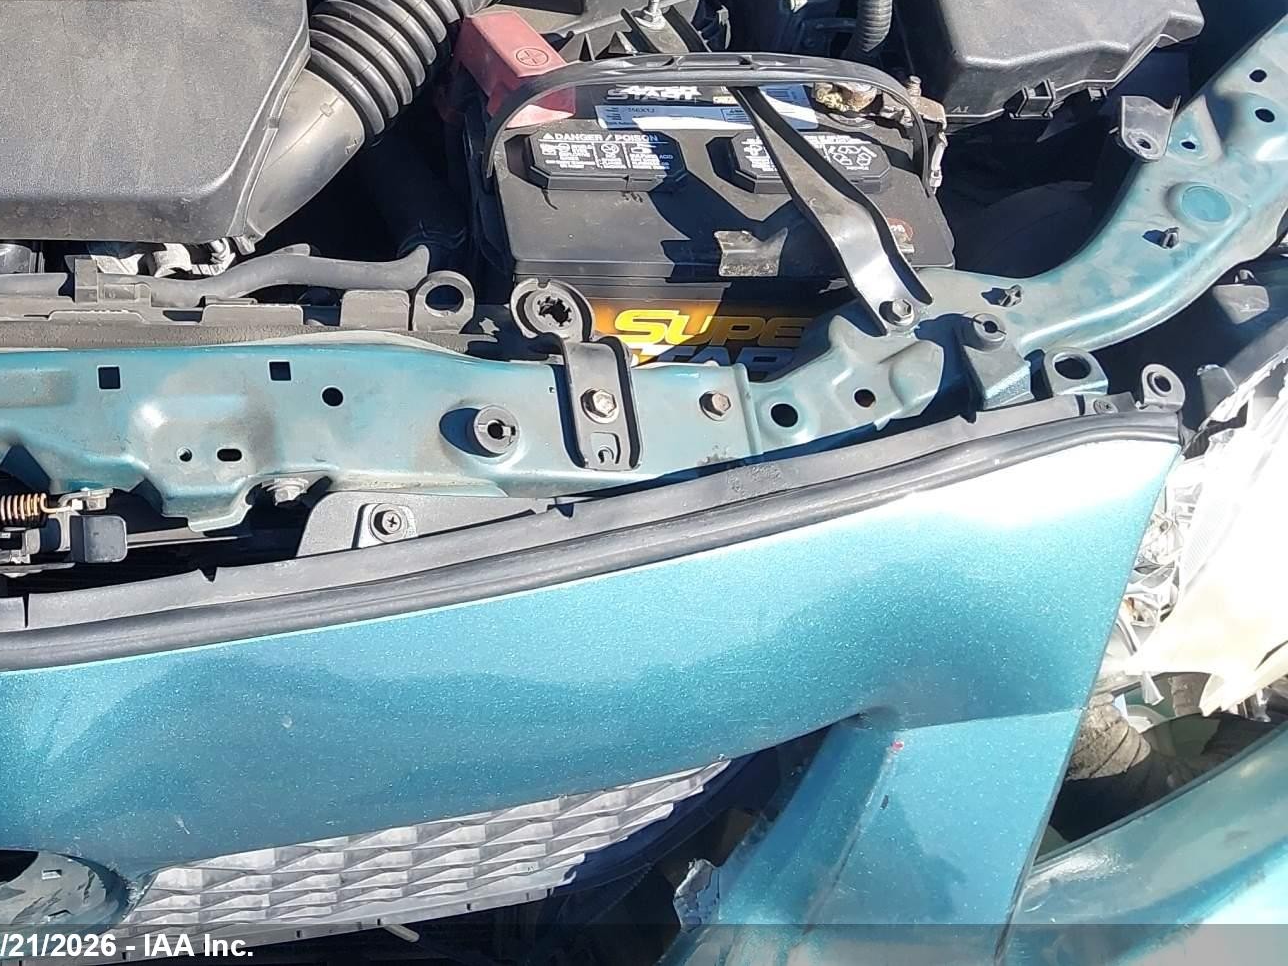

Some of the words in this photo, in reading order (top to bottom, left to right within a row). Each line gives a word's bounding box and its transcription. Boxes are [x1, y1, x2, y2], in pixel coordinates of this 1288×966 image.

[555, 133, 603, 142] DANGER
[614, 133, 659, 143] POISON
[614, 309, 812, 347] SUPE
